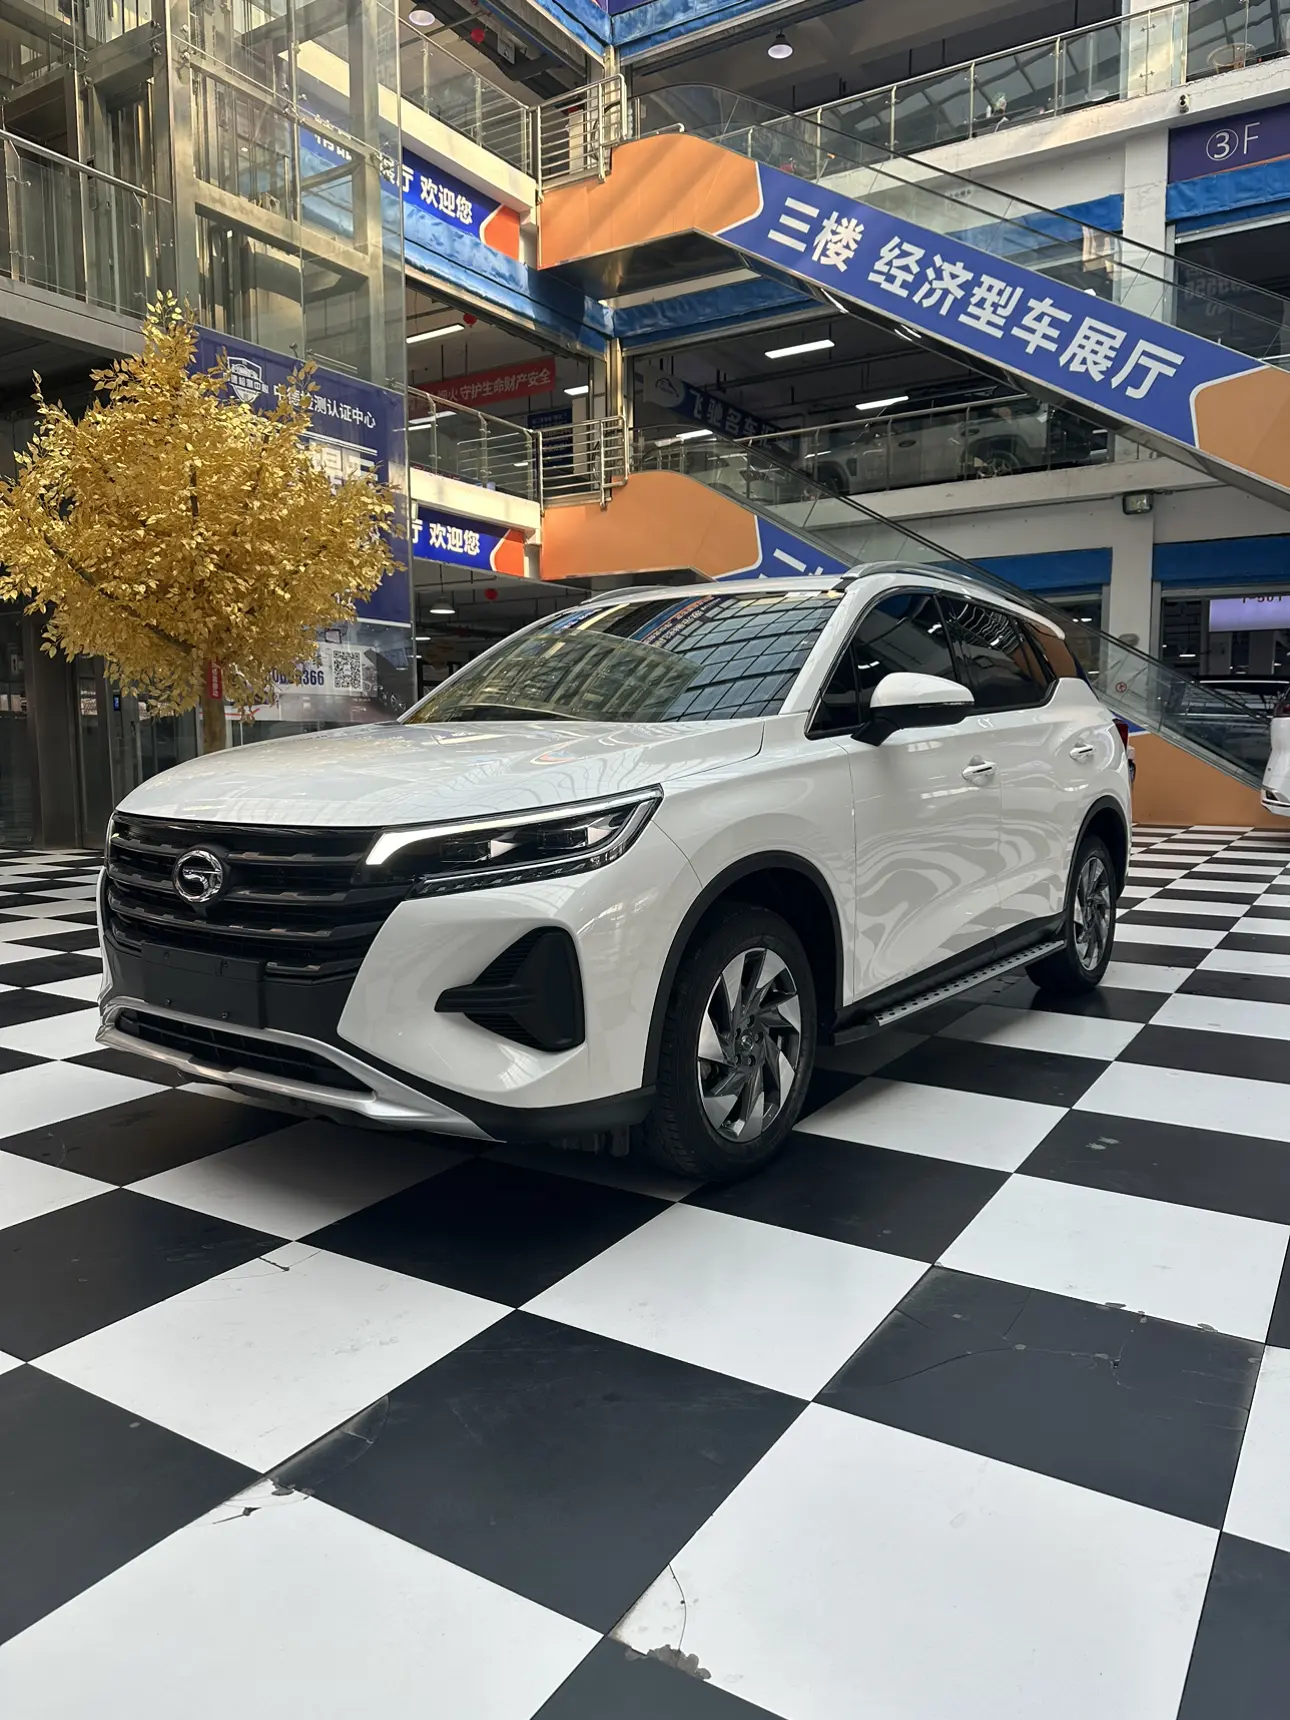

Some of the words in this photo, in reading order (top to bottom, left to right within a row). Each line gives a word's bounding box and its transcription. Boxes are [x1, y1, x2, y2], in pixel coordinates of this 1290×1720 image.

[420, 176, 473, 225] 欢迎您
[767, 197, 864, 272] 三楼
[867, 236, 1186, 399] 经济型车展厅
[460, 368, 551, 400] 守护生命财产安全
[429, 523, 480, 556] 欢迎您
